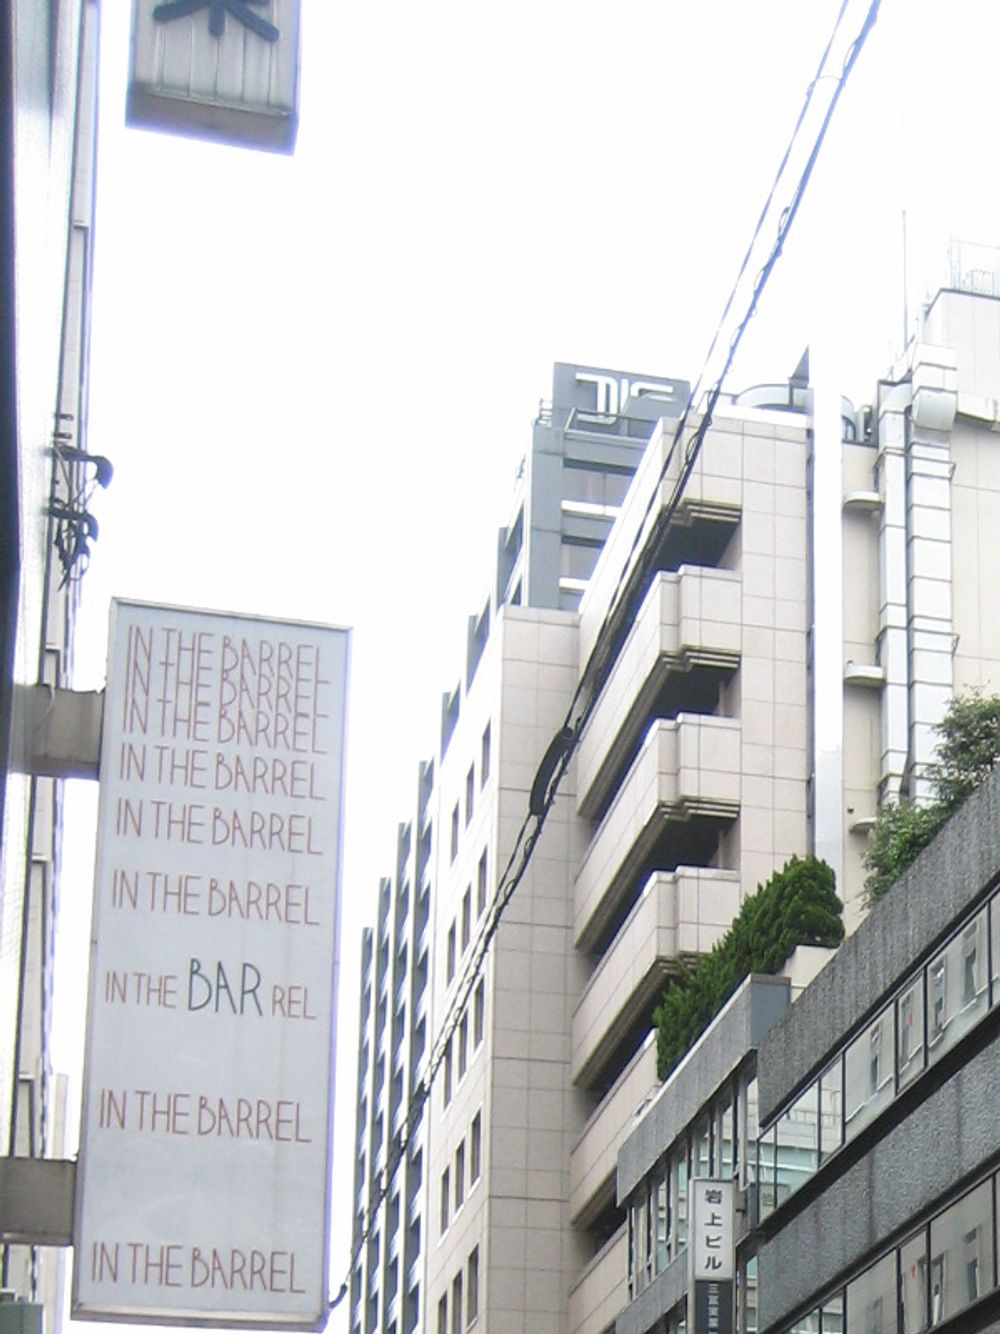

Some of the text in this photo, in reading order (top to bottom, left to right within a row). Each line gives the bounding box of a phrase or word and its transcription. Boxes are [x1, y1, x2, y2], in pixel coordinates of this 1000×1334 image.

[128, 624, 330, 684] IN THE BARREL
[126, 661, 330, 717] IN THE BARREL
[123, 698, 328, 755] IN THE BARREL
[120, 742, 327, 801] IN THE BARREL
[116, 798, 323, 855] IN THE BARREL
[112, 869, 321, 926] IN THE BARREL
[105, 971, 128, 1004] IN
[133, 972, 177, 1009] THE
[100, 1089, 312, 1143] IN THE BARREL
[705, 1190, 722, 1270] 岩上ビル
[92, 1242, 306, 1294] IN THE BARREL
